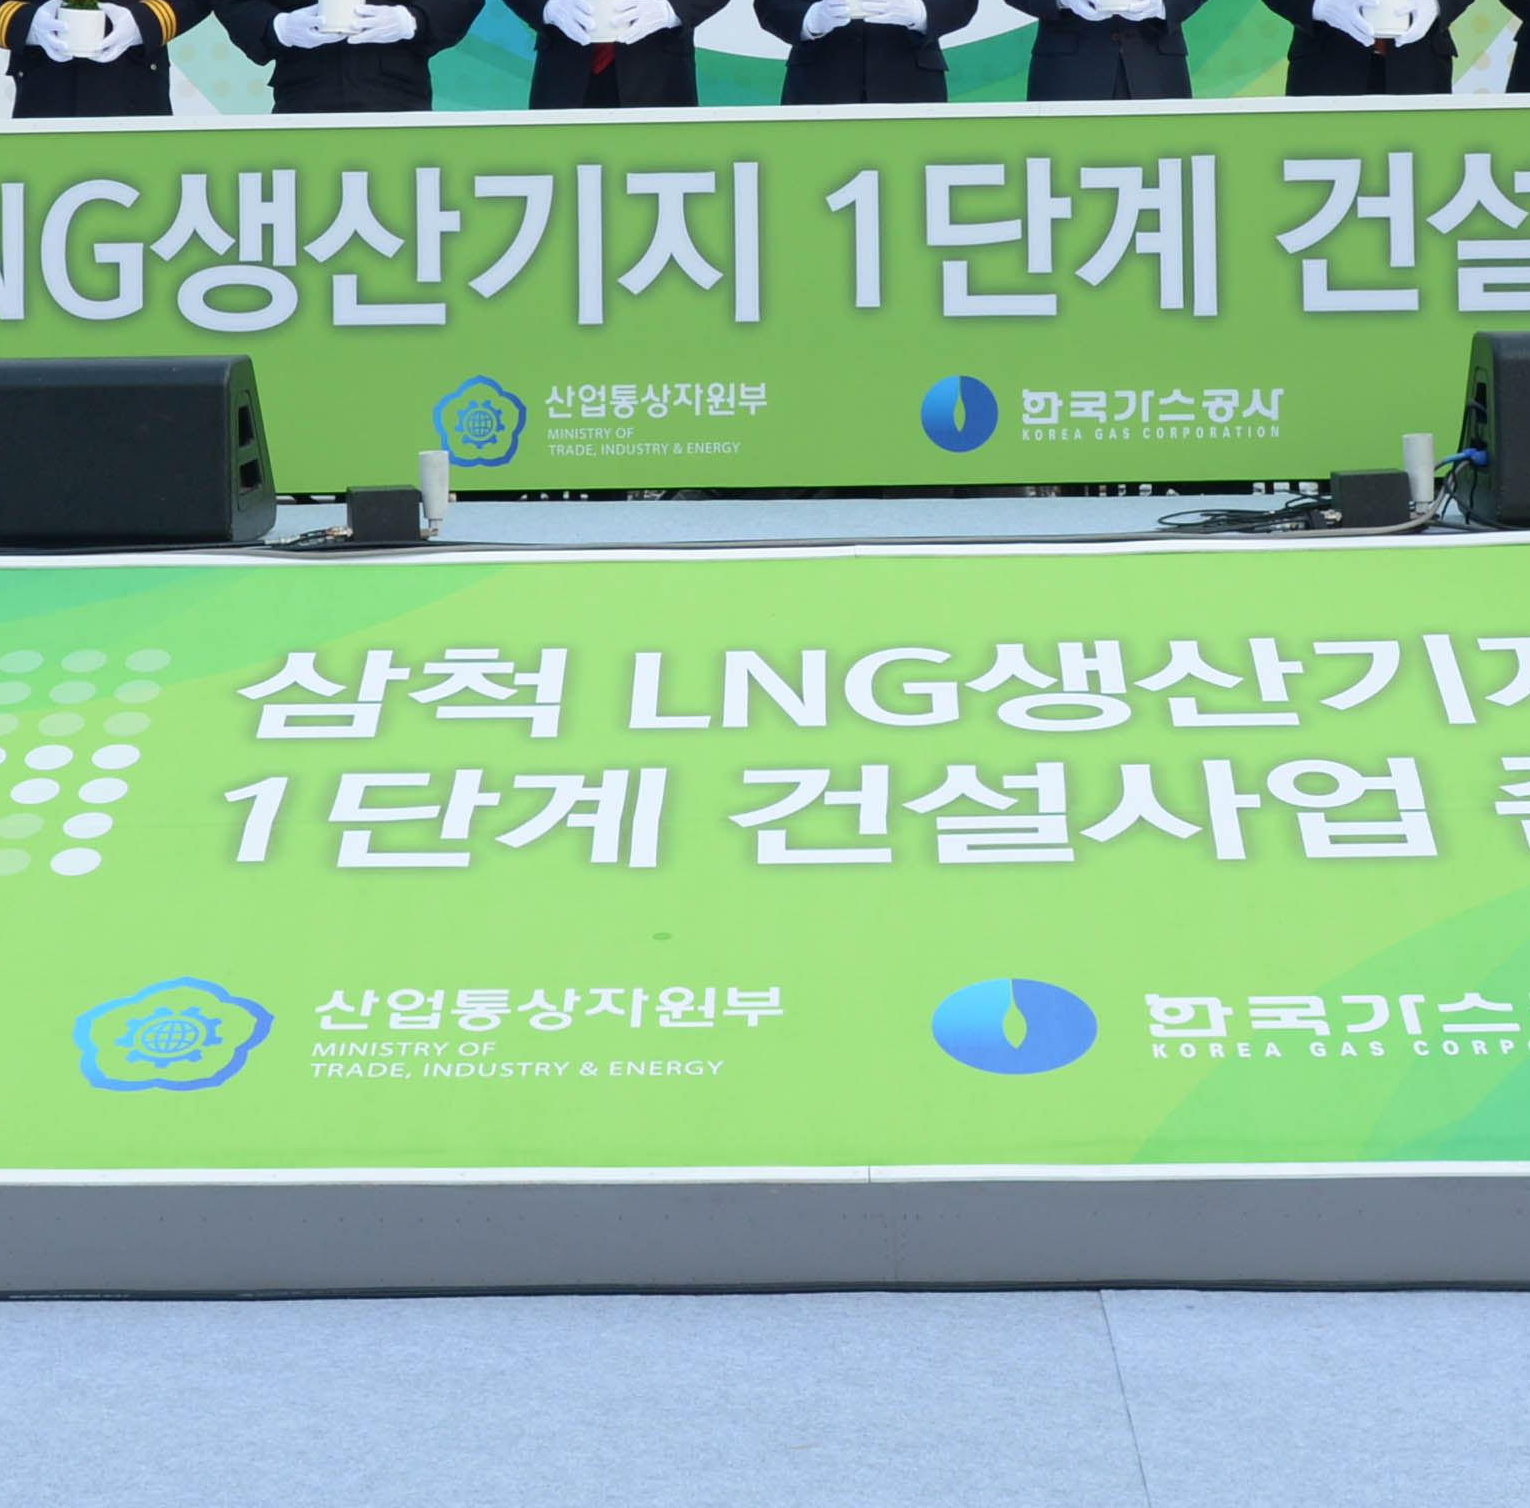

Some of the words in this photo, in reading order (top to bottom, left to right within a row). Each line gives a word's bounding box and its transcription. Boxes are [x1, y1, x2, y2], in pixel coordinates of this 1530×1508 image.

[825, 155, 1219, 318] 1단계
[545, 382, 768, 419] 산업통상자원부
[1022, 388, 1285, 424] 한국가스공사
[547, 428, 611, 440] MINISTRY
[615, 427, 635, 439] OF
[1022, 428, 1083, 441] KOREA
[1094, 428, 1131, 440] GAS
[1142, 426, 1281, 440] CORPORATION
[548, 444, 598, 458] TRADE,
[601, 443, 670, 456] INDUSTRY
[673, 443, 683, 455] &
[686, 442, 742, 454] ENERGY
[237, 647, 569, 739] 삼척
[224, 767, 668, 868] 1단계
[728, 756, 1439, 865] 건설사업
[315, 985, 784, 1031] 산업통상자원부
[311, 1041, 449, 1057] MINISTRY
[457, 1041, 497, 1057] OF
[1151, 1042, 1283, 1059] KOREA
[1309, 1040, 1385, 1058] GAS
[310, 1061, 413, 1080] TRADE,
[423, 1061, 570, 1078] INDUSTRY
[578, 1060, 600, 1077] &
[608, 1059, 725, 1077] ENERGY
